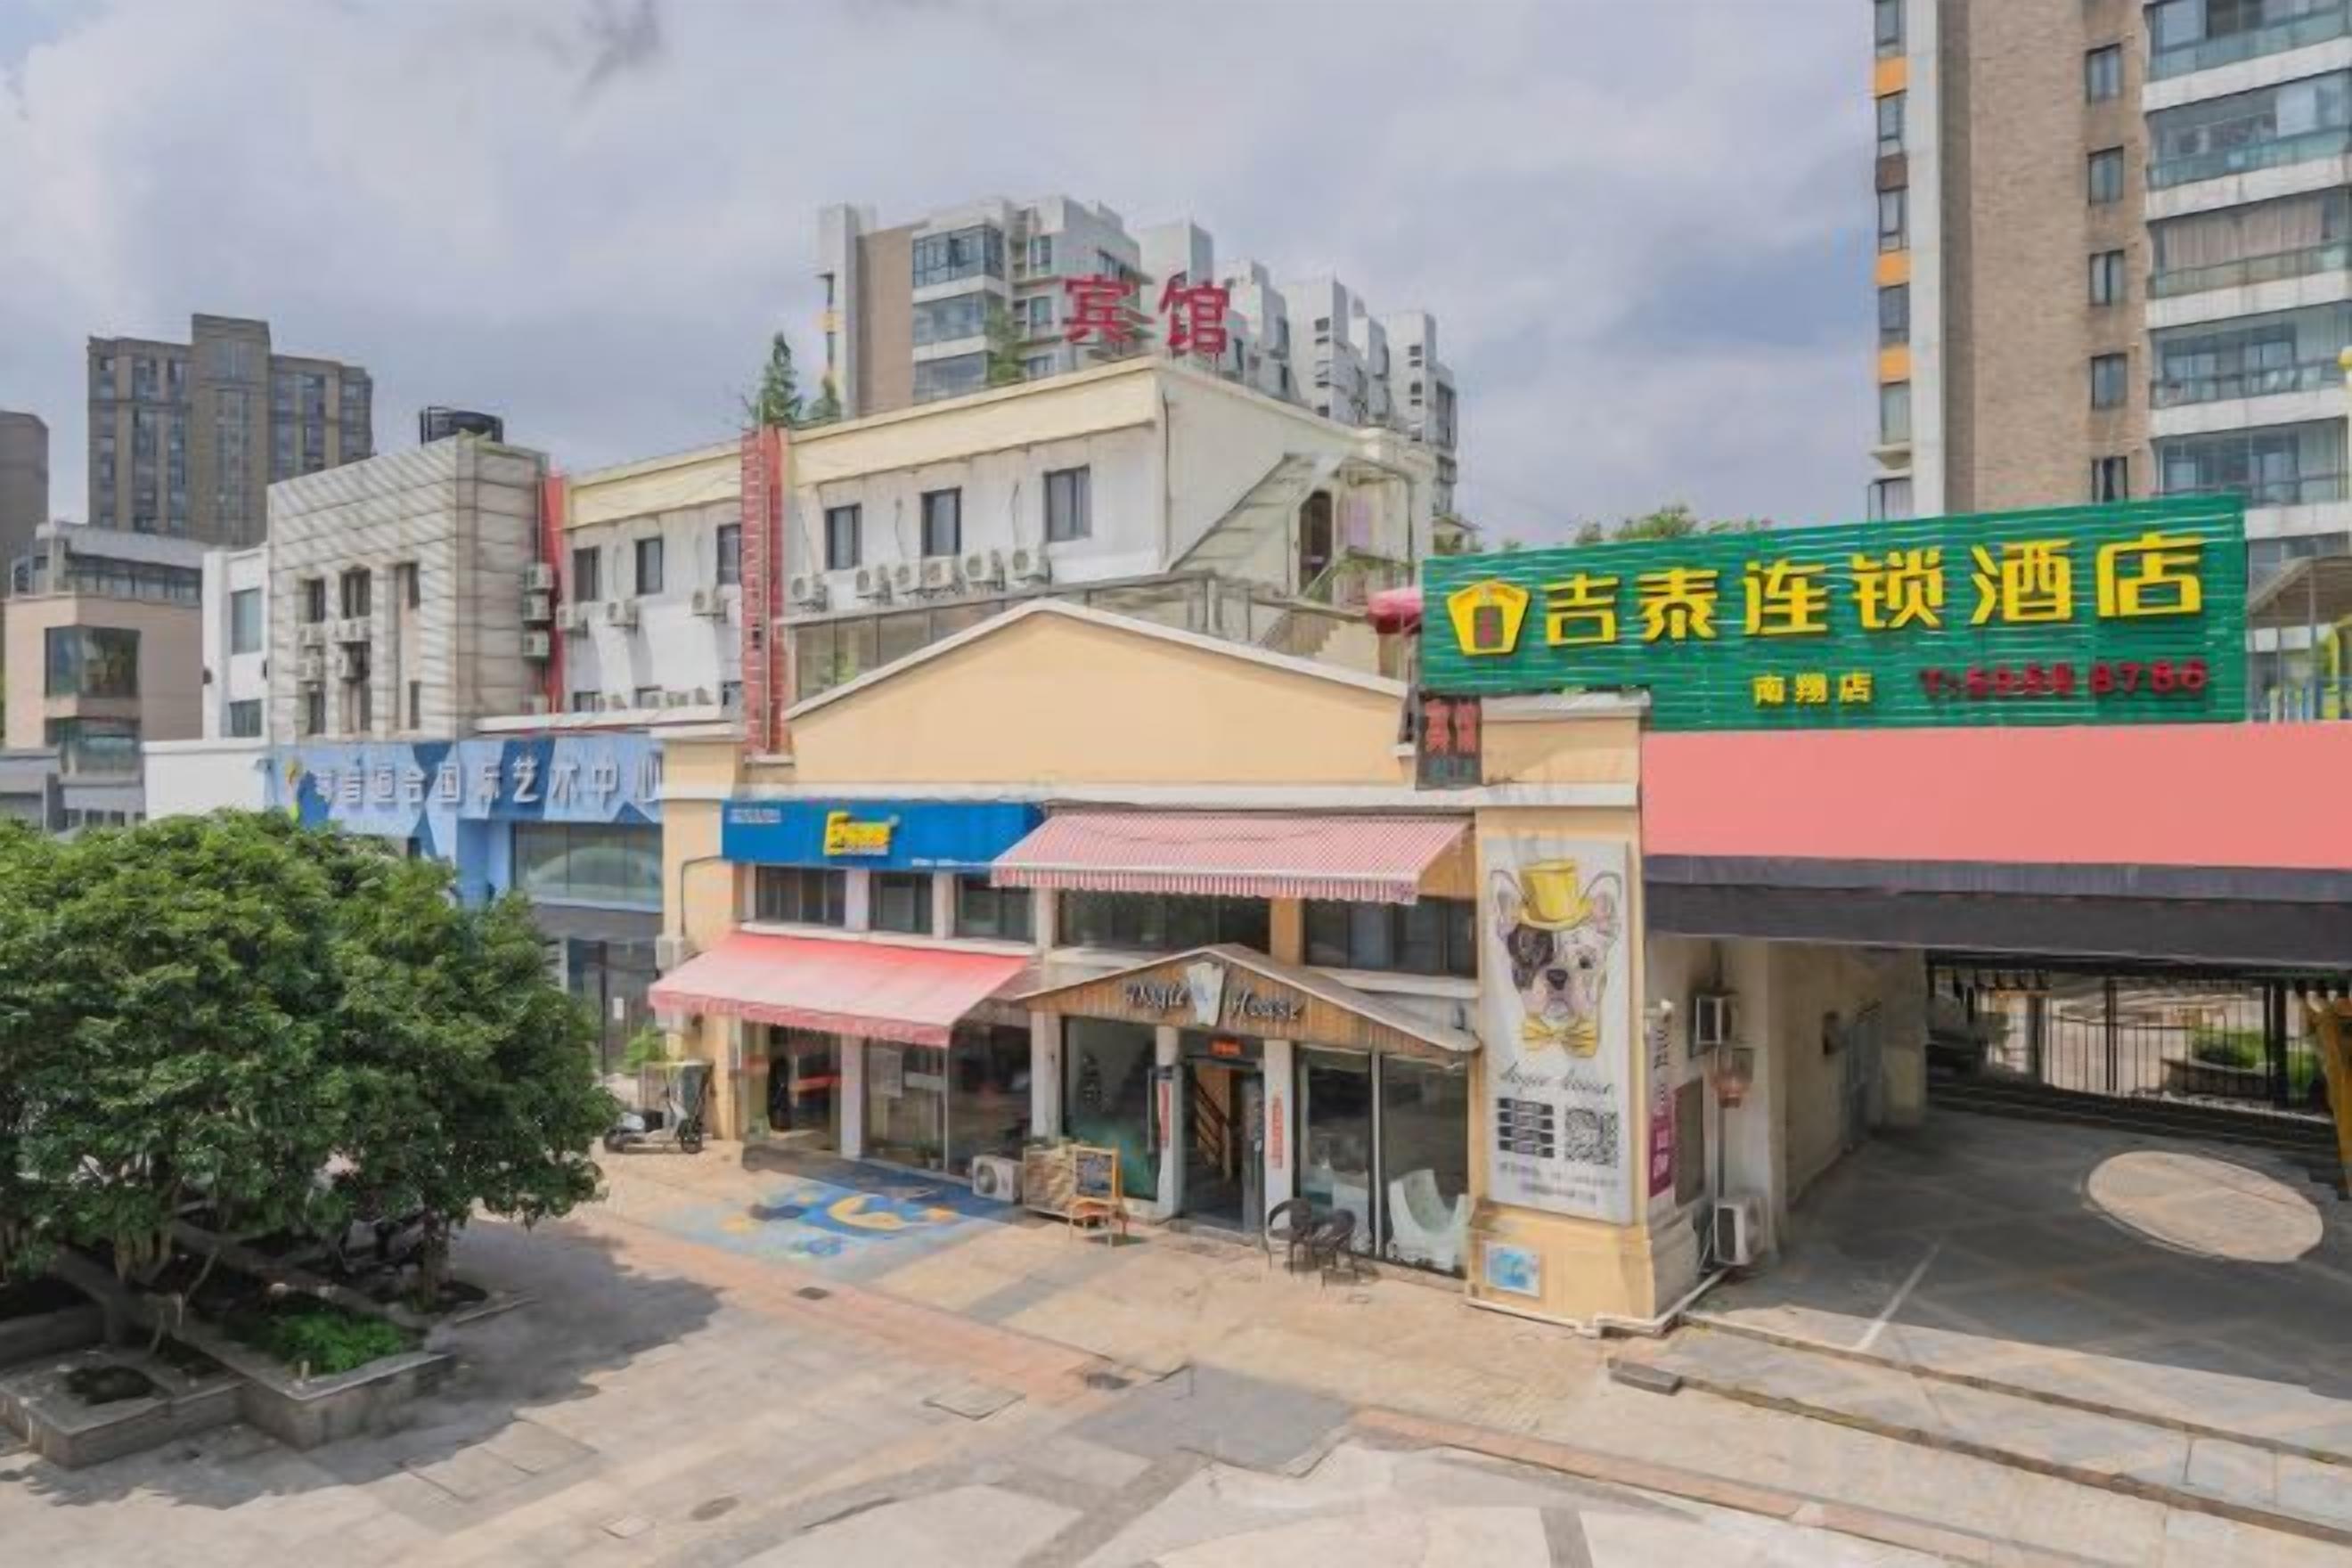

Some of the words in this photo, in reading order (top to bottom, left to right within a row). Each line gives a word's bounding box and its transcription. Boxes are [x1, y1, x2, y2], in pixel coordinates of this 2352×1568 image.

[1062, 271, 1231, 354] 宾馆
[1543, 534, 2204, 648] 吉泰连锁酒店
[1752, 670, 1874, 706] 南翔店
